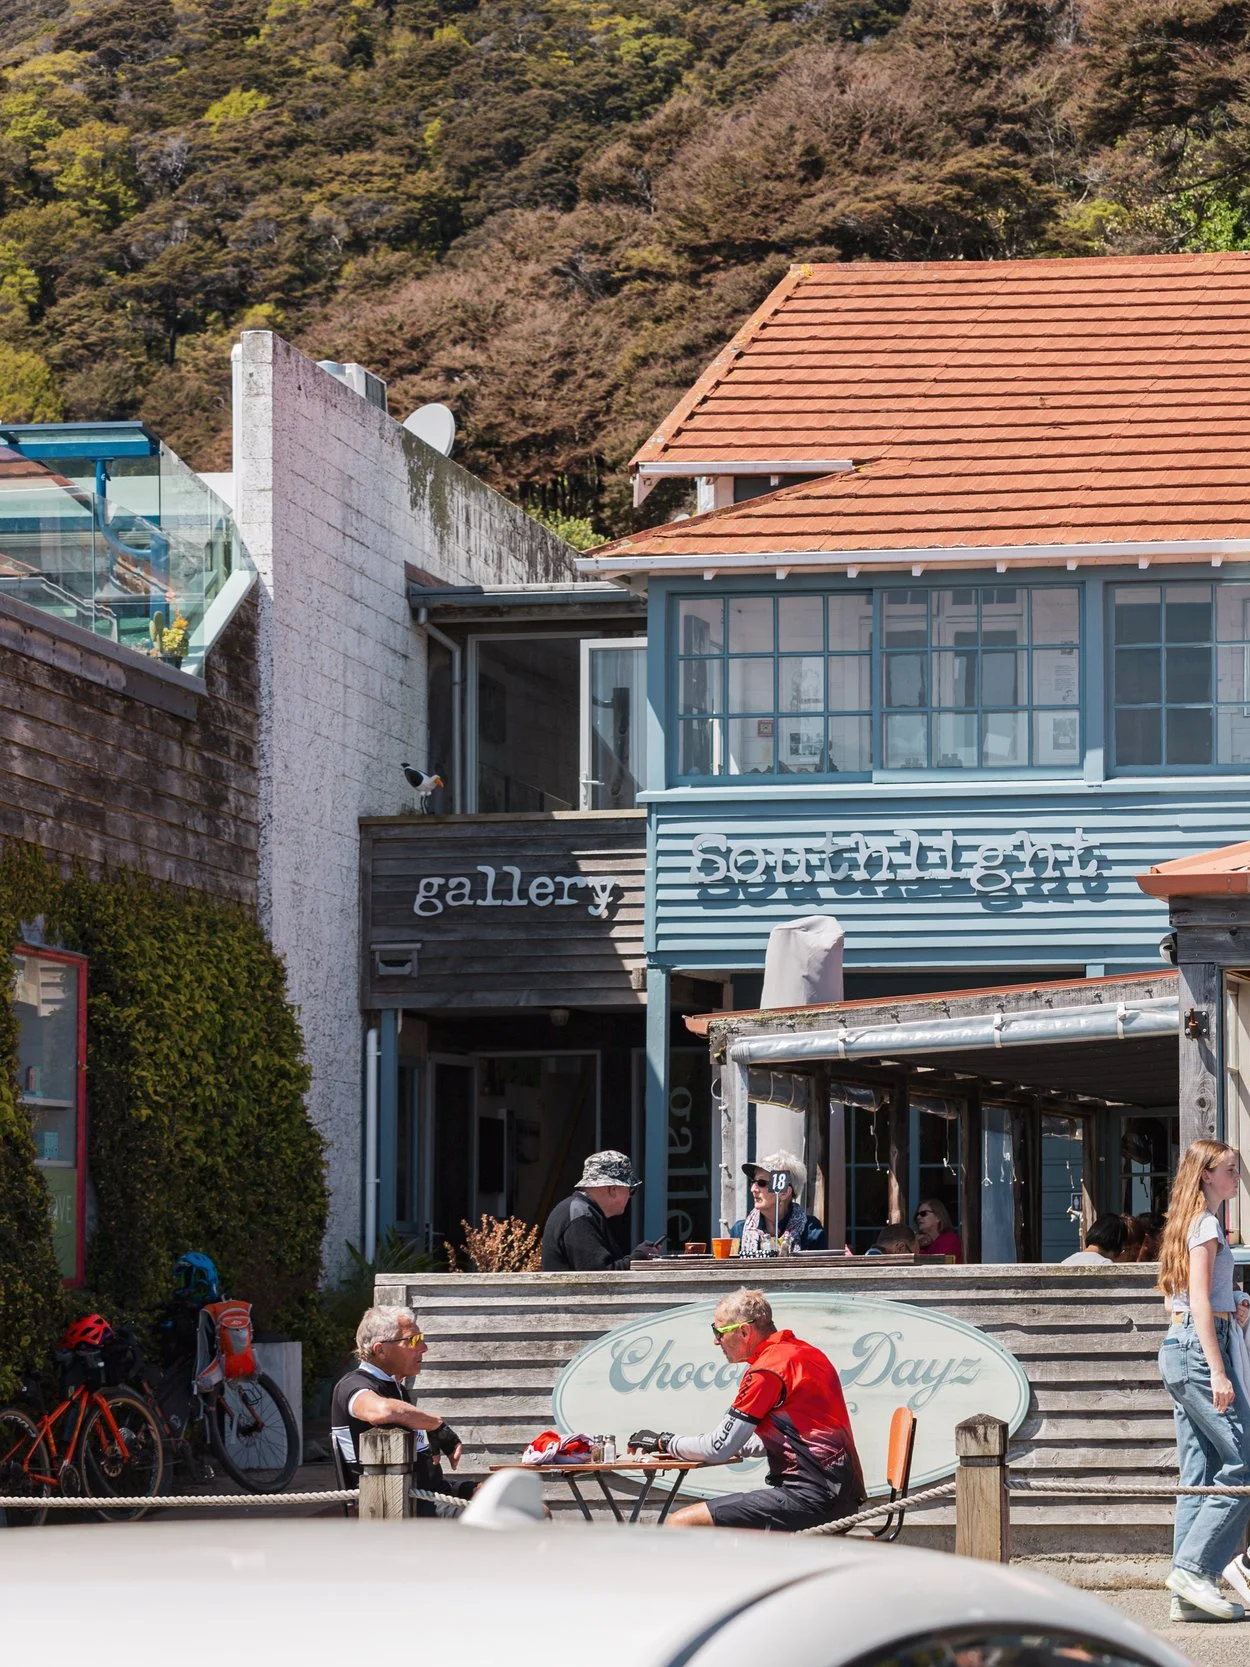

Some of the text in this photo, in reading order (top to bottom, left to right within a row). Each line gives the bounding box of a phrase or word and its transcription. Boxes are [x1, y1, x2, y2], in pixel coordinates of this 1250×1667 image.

[689, 828, 1100, 891] Southlight
[413, 866, 618, 916] gallery
[772, 1173, 787, 1190] 18
[608, 1335, 749, 1393] Choco
[840, 1331, 983, 1410] Dayz
